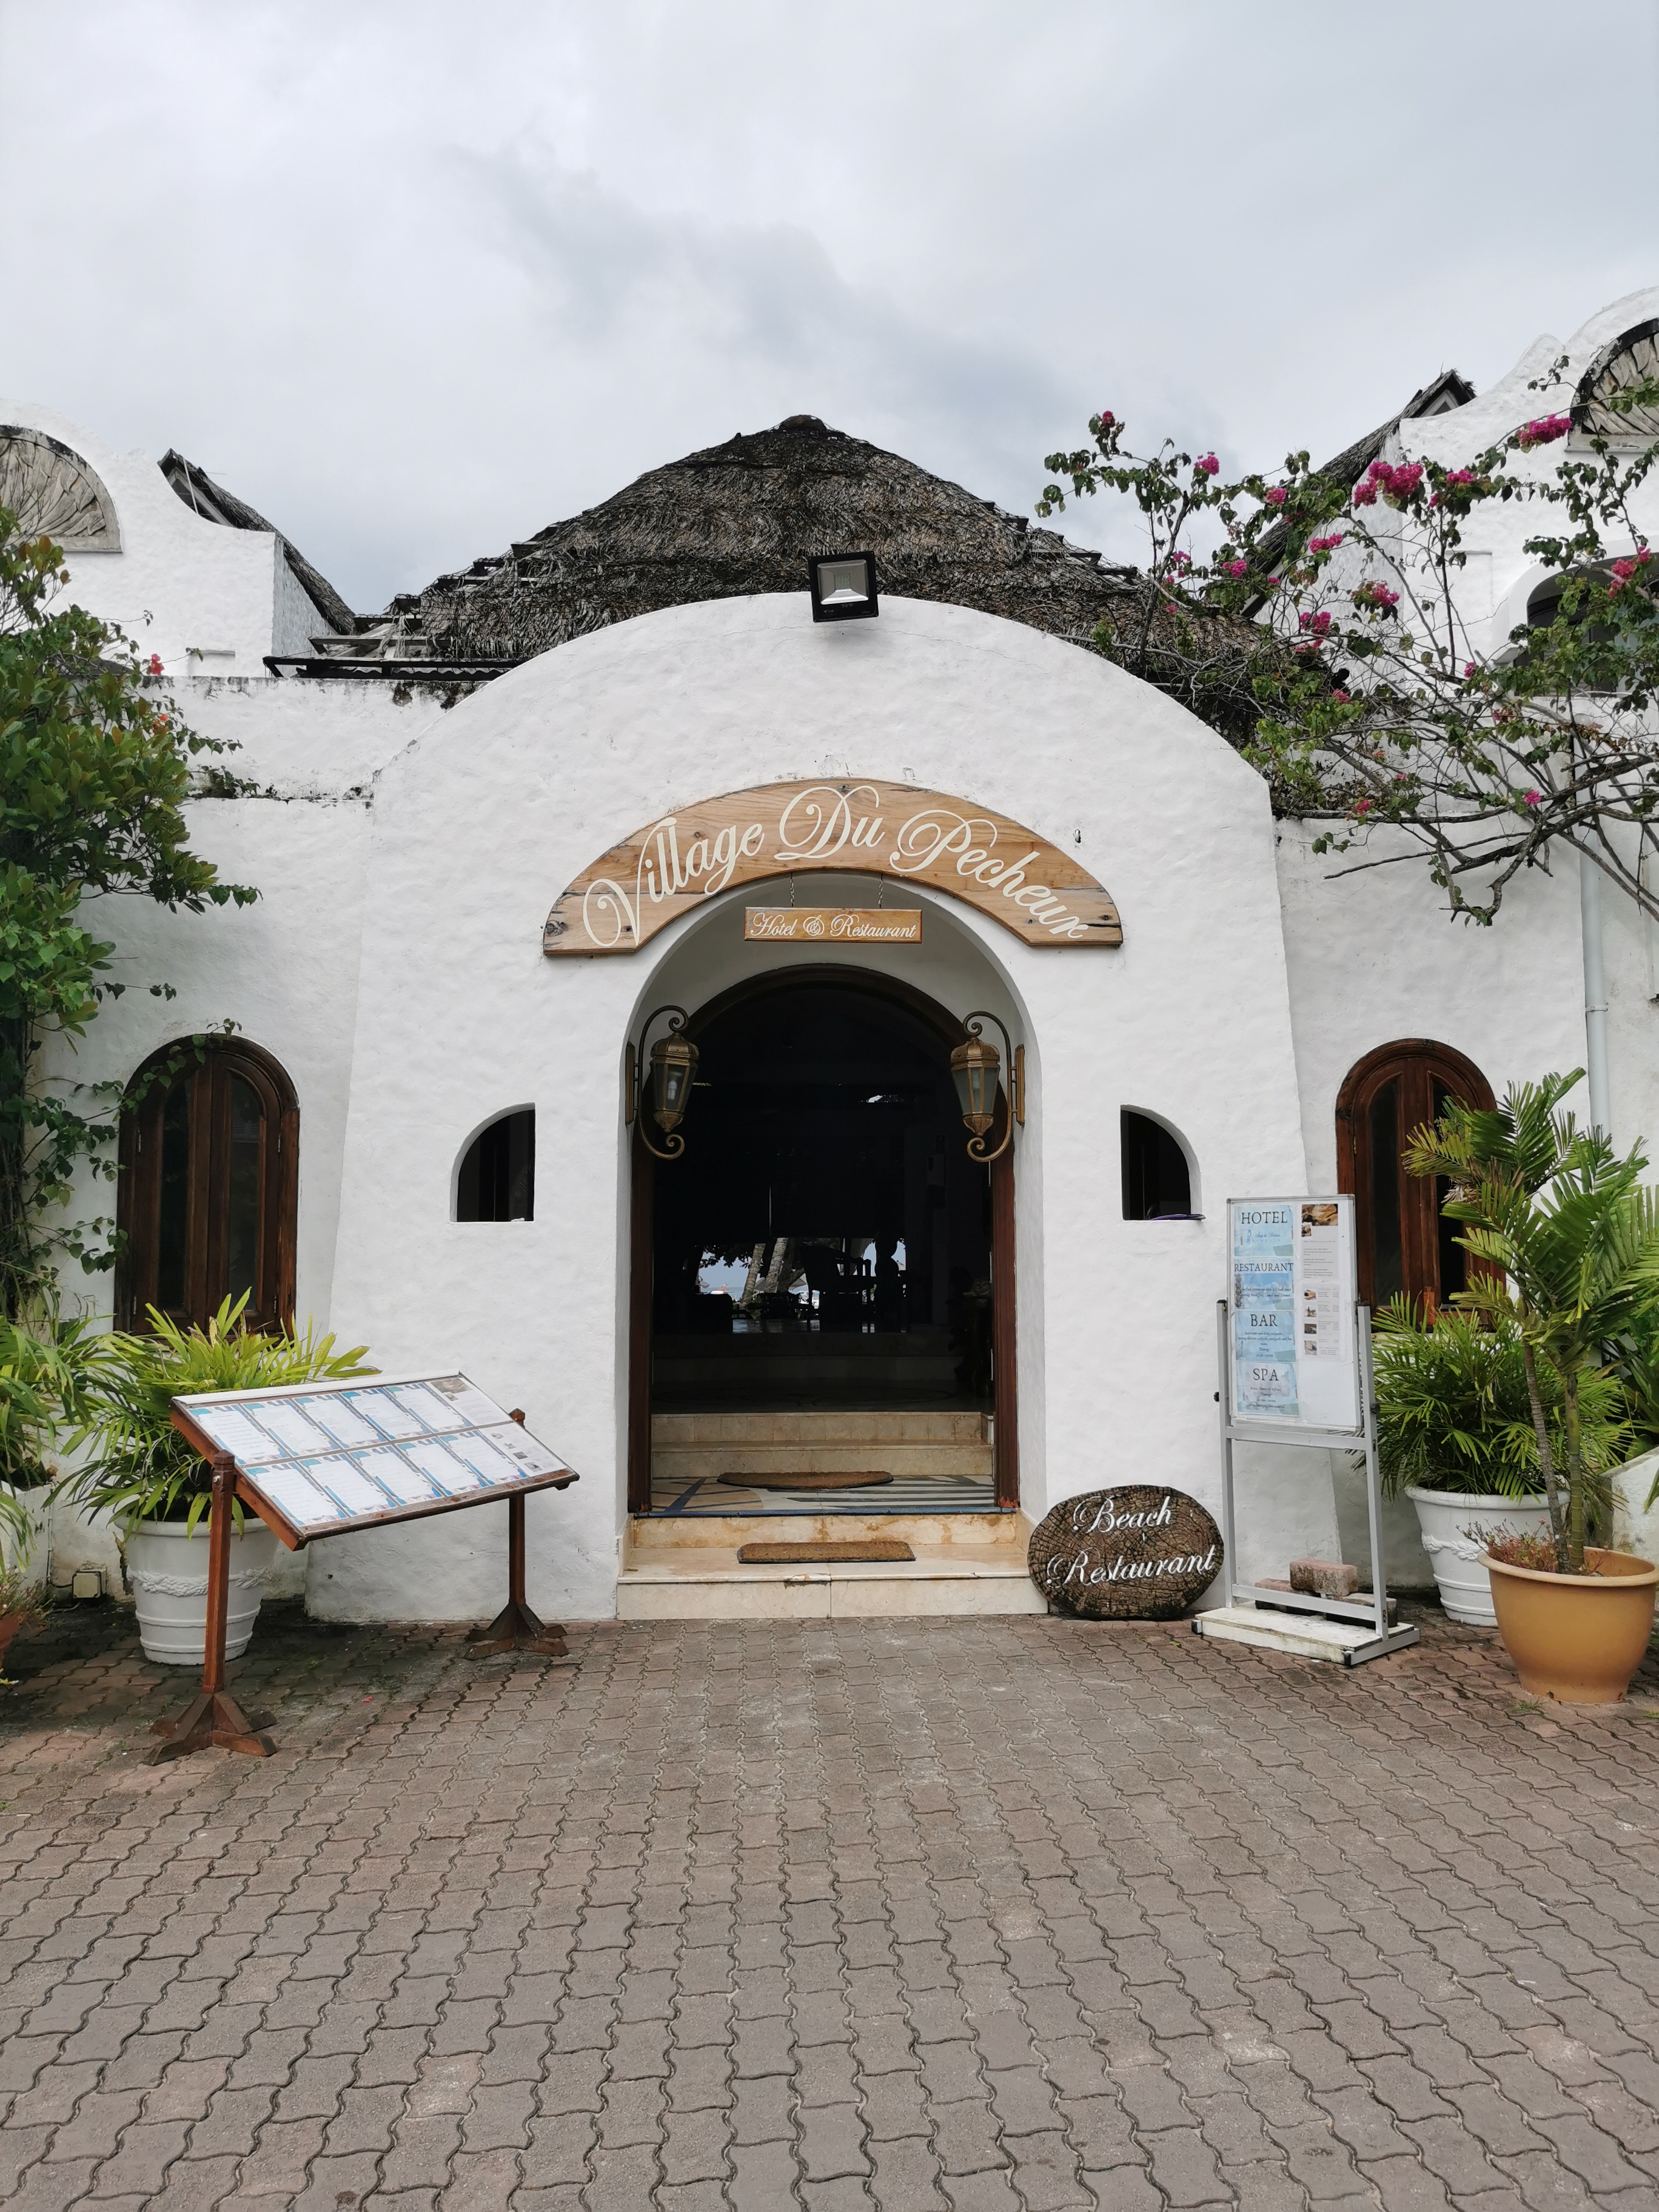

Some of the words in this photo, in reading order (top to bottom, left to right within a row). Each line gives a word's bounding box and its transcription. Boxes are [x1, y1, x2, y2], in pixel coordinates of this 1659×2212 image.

[583, 817, 765, 947] Village
[774, 785, 885, 860] Du
[750, 913, 798, 936] Hotel
[803, 914, 825, 936] &
[830, 914, 917, 938] Restaurant
[1241, 1211, 1288, 1224] HOTEL
[1233, 1262, 1294, 1272] RESTAURANT
[1250, 1313, 1278, 1327] BAR
[1252, 1367, 1279, 1381] SPA
[1072, 1494, 1171, 1534] Beach
[1046, 1544, 1216, 1589] Restaurant
